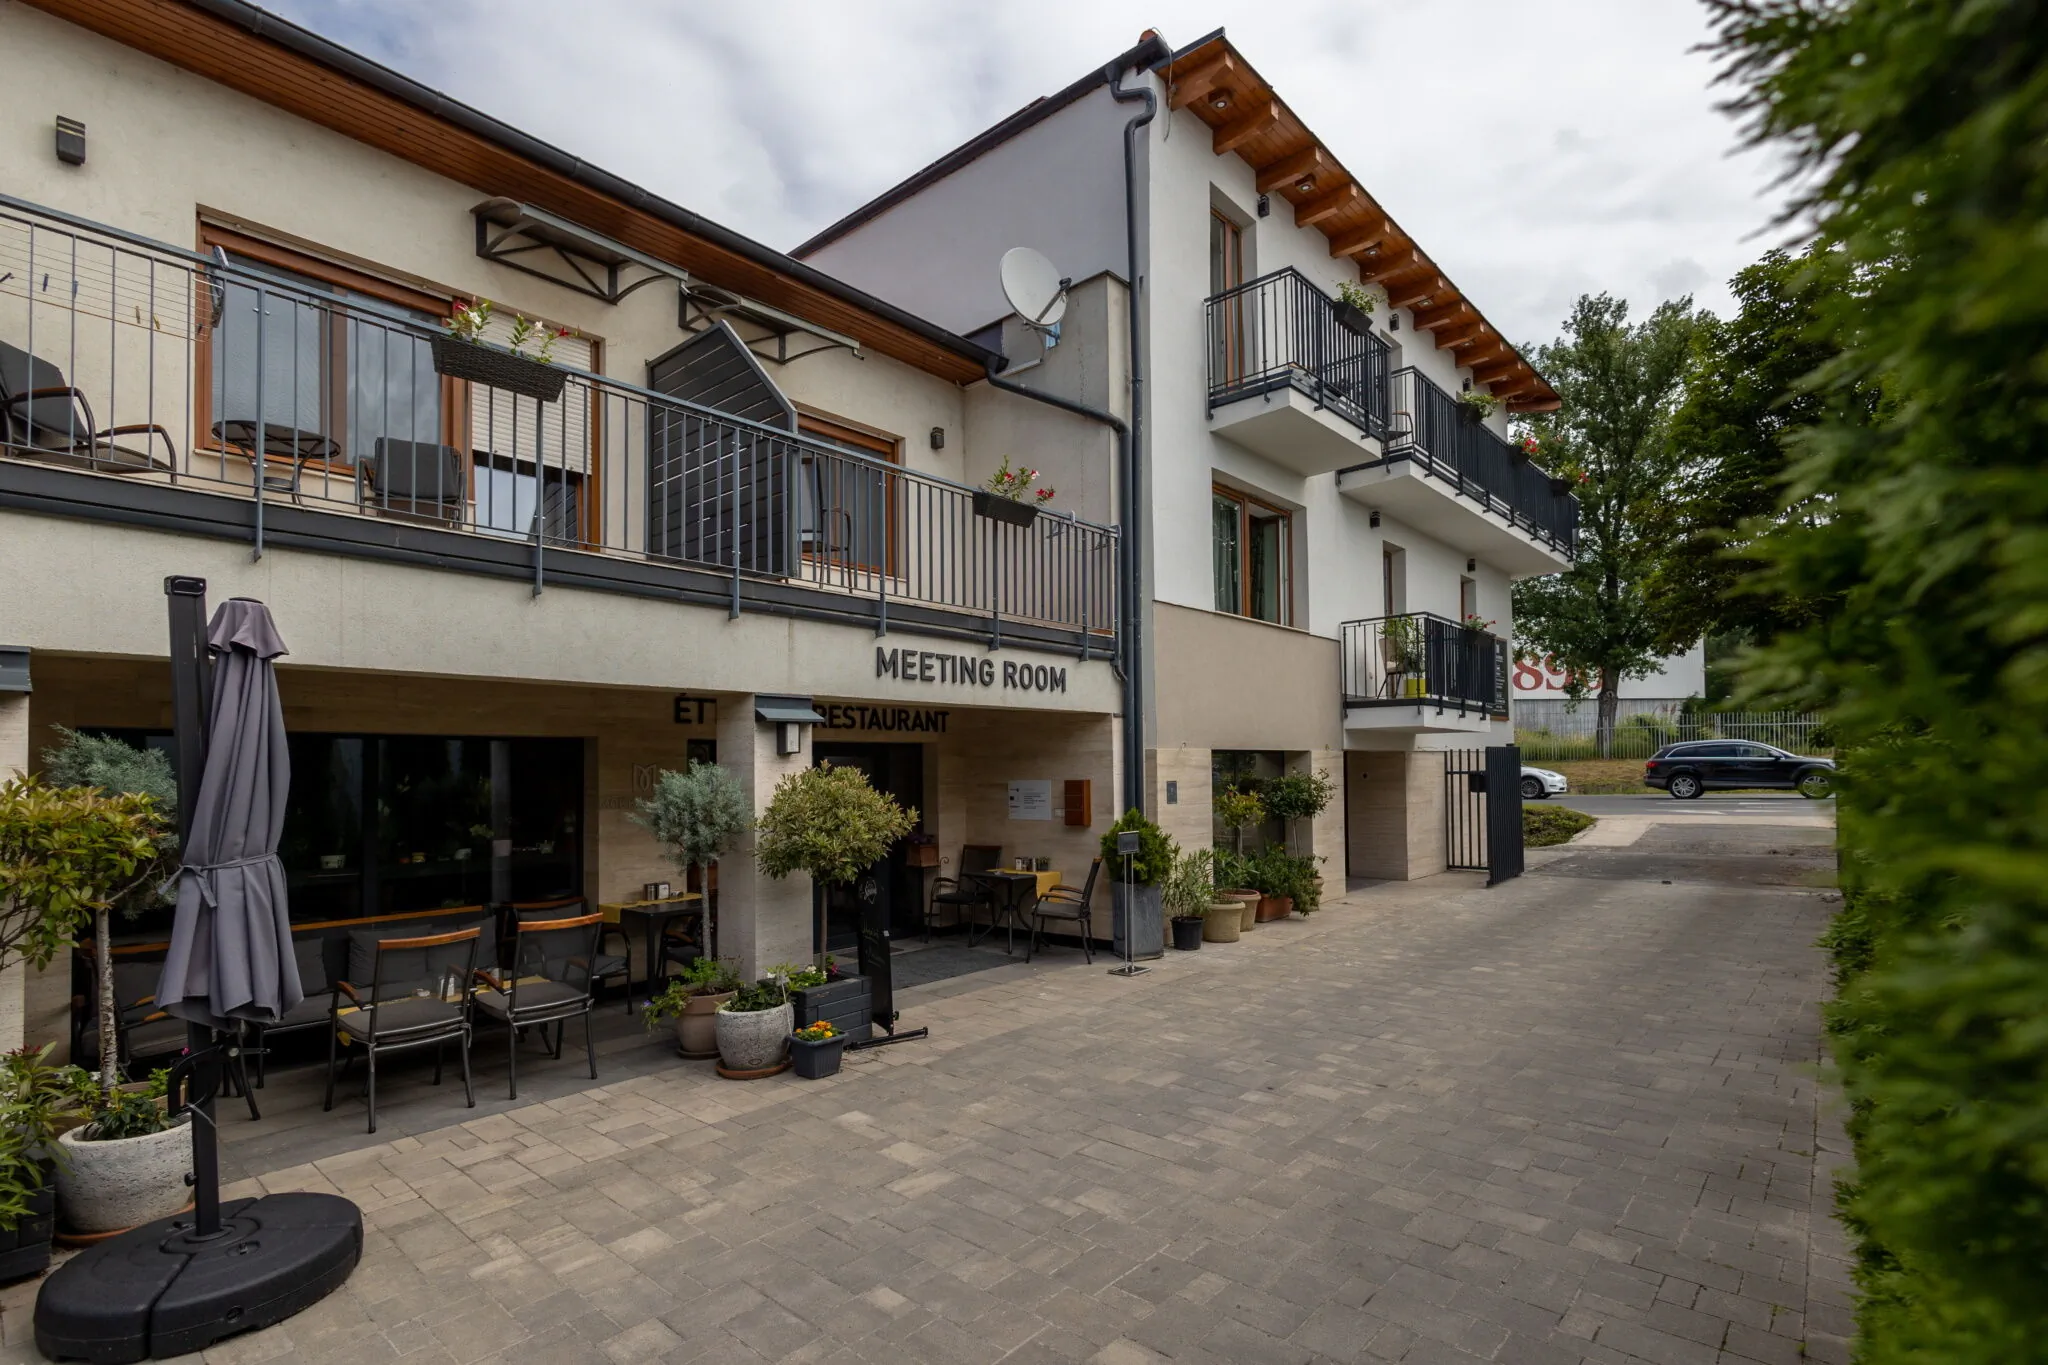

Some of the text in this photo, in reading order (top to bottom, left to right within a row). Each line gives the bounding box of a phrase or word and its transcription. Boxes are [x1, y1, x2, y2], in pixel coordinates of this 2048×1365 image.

[876, 646, 1067, 693] MEETING ROOM
[813, 704, 949, 732] RESTAURANT
